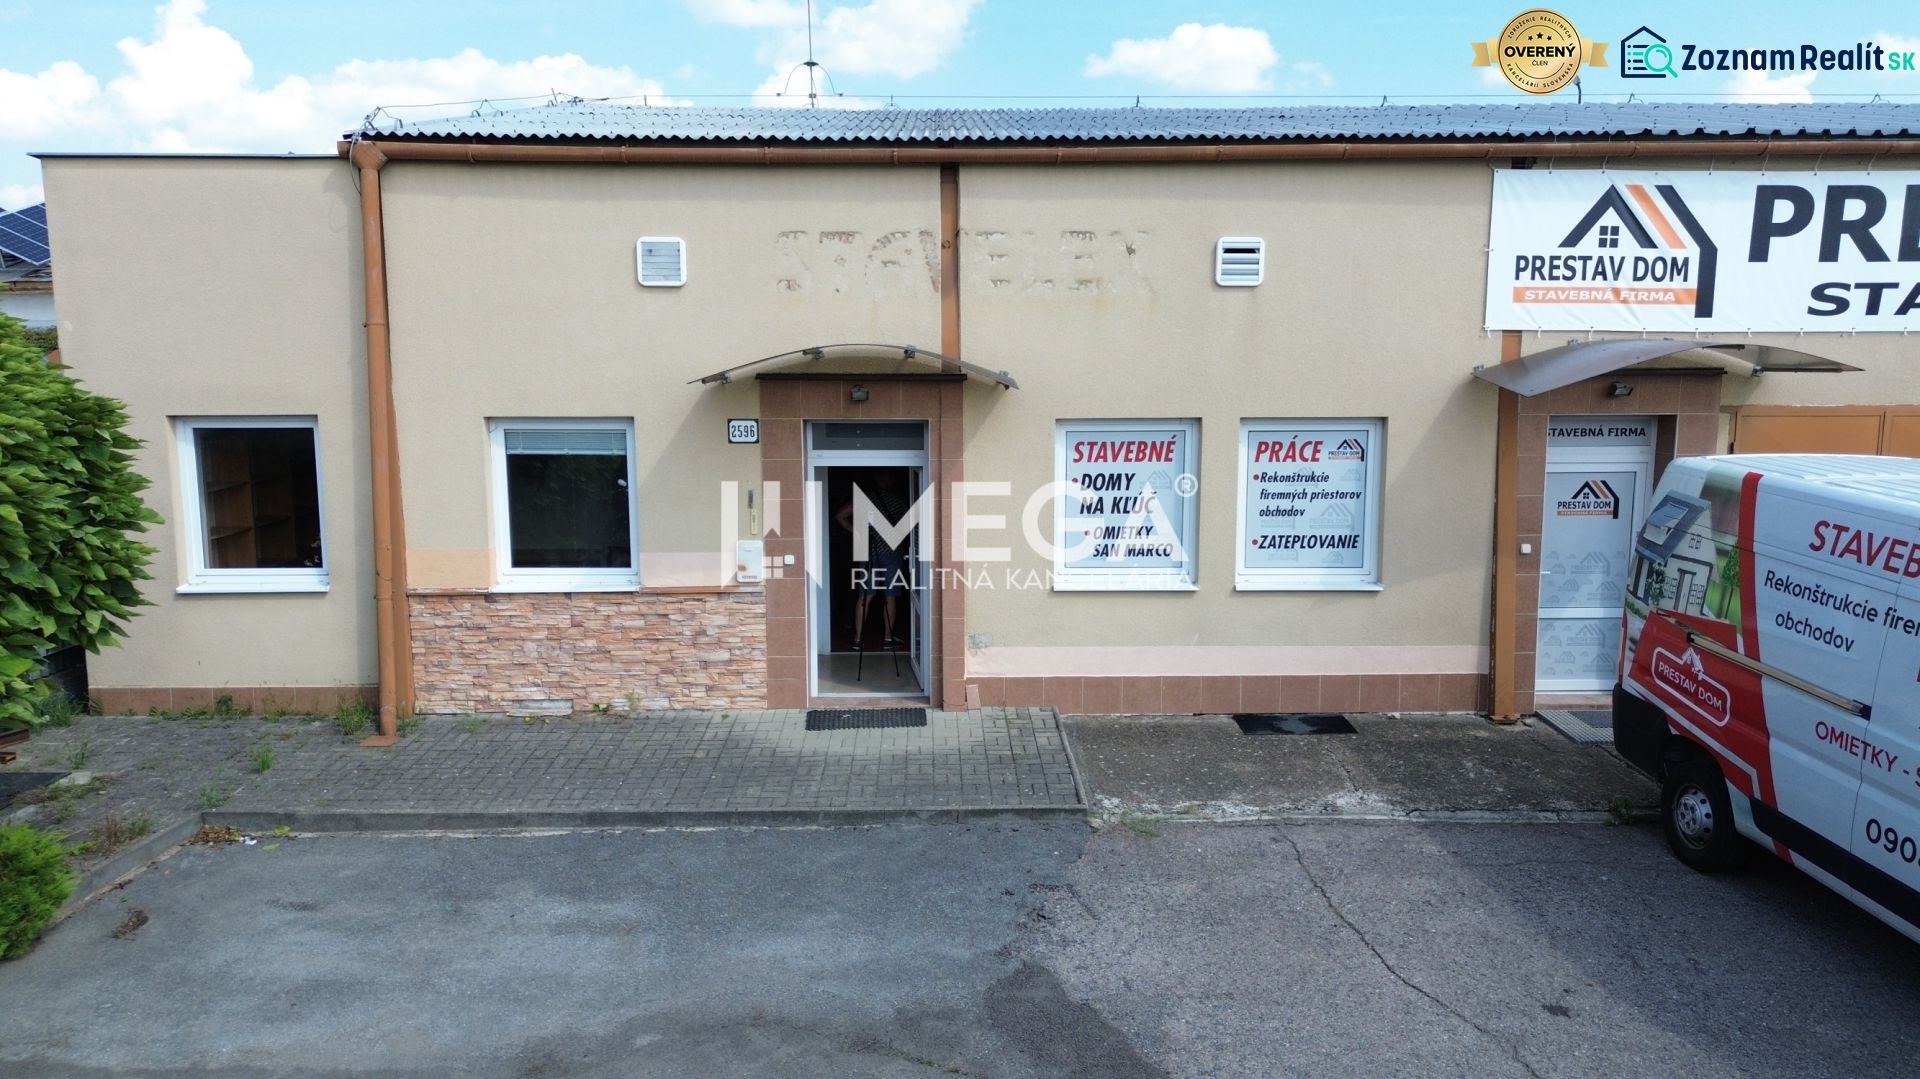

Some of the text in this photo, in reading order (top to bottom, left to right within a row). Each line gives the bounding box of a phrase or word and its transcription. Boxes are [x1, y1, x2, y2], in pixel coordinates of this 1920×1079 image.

[1514, 255, 1690, 283] PRESTAV DOM
[1524, 287, 1676, 302] STAVEBNÁ FIRMA
[731, 424, 756, 438] 2596
[1548, 425, 1646, 437] TAVEBNÁ FIRMA
[1072, 434, 1177, 463] STAVEBNÉ
[1254, 434, 1324, 463] PRÁCE
[1080, 473, 1136, 491] DOMY
[1260, 471, 1330, 483] Rekonštrukcie
[1260, 488, 1362, 503] firemných priestorov
[1080, 496, 1104, 515] NA
[1259, 505, 1306, 517] obchodov
[1557, 500, 1612, 510] PRESTAV DOM
[1093, 526, 1154, 540] OMIETKY
[1258, 534, 1360, 549] ZATEPĽOVANIE
[1093, 543, 1173, 557] SAN MARCO
[1764, 570, 1920, 637] Rekonštrukcie fire
[1775, 611, 1855, 652] obchodov
[1658, 661, 1722, 711] PRESTAV DOM
[1815, 721, 1898, 773] OMIETKY
[1866, 818, 1920, 867] 090
